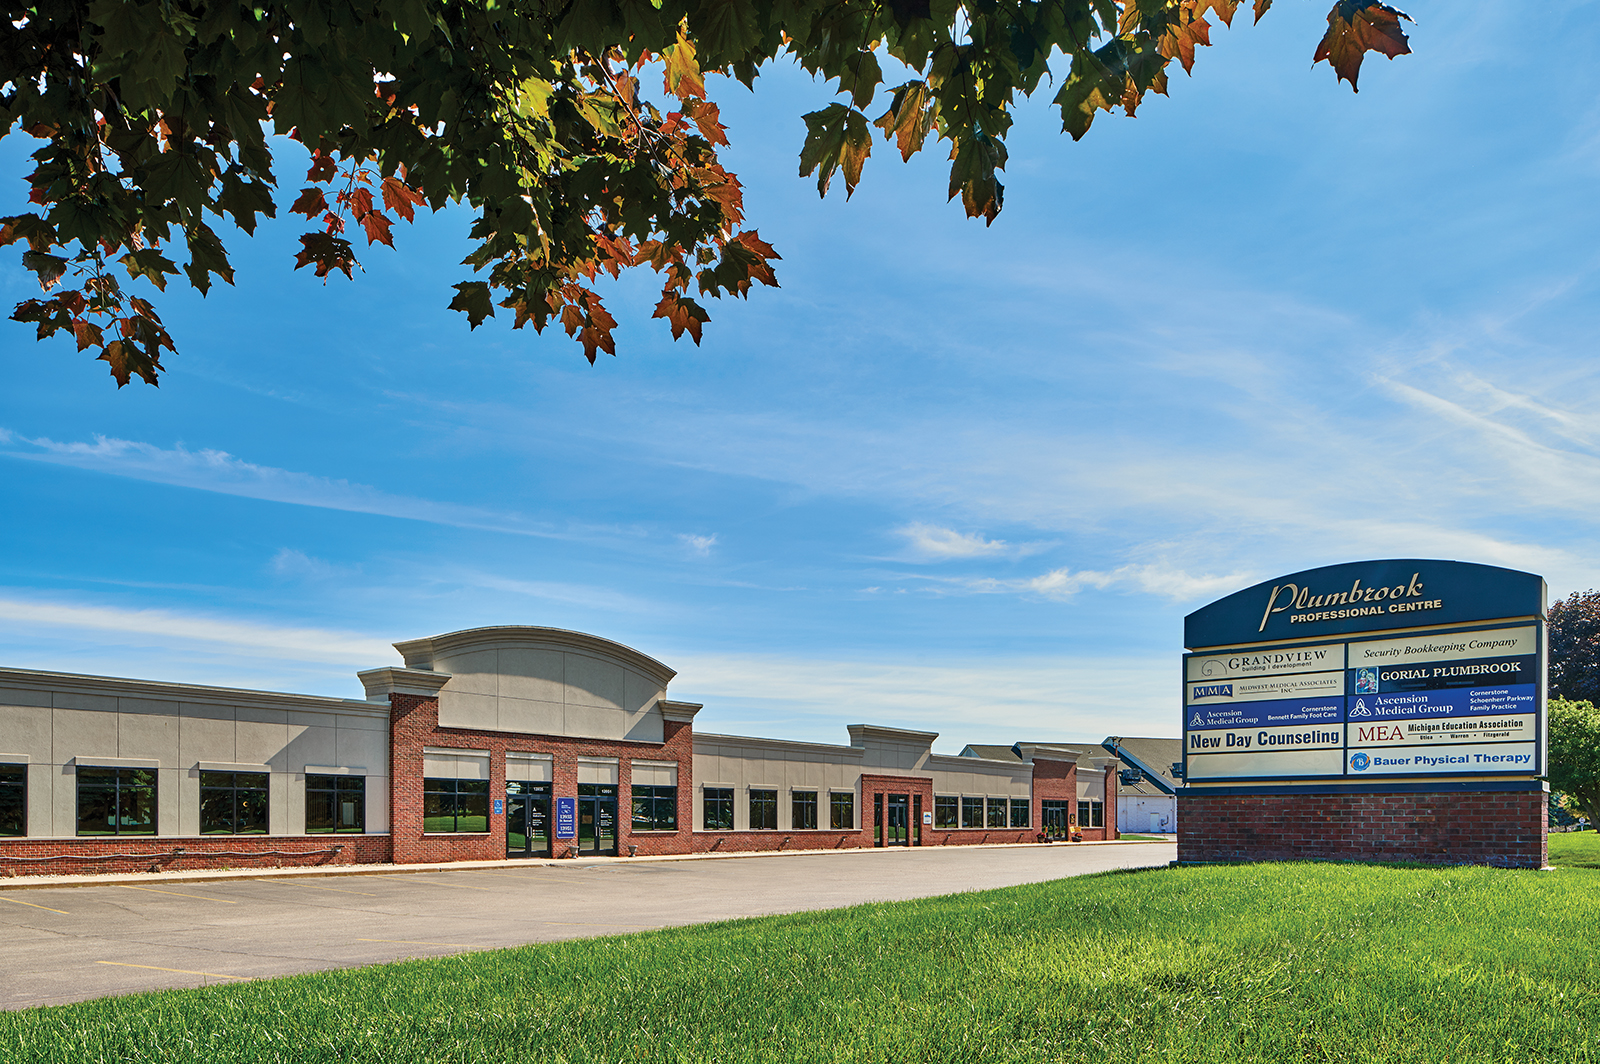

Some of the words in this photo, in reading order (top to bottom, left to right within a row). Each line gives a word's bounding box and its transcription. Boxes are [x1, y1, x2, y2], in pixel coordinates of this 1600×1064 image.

[1258, 572, 1423, 632] Plumbrook
[1290, 605, 1385, 624] PROFESSIONAL
[1388, 599, 1442, 613] CENTRE
[1364, 647, 1402, 658] Security
[1404, 642, 1466, 655] Bookkeeping
[1468, 637, 1518, 650] Company
[1228, 650, 1327, 670] GRANDVIEW
[1242, 664, 1266, 672] building
[1272, 661, 1312, 670] development
[1381, 668, 1430, 681] GORIAL
[1433, 661, 1522, 678] PLUMBROOK
[1299, 679, 1337, 687] ASSOCIATES
[1194, 686, 1230, 696] MMA
[1470, 688, 1509, 696] Cornerstone
[1375, 695, 1428, 706] Ascension
[1470, 696, 1506, 704] Schoenherr
[1507, 695, 1534, 703] Parkway
[1301, 705, 1337, 713] Cornerstone
[1375, 705, 1416, 716] Medical
[1419, 703, 1453, 715] Group
[1470, 704, 1491, 712] Family
[1492, 703, 1517, 711] Practice
[1207, 710, 1242, 718] Ascension
[1290, 713, 1309, 721] Family
[1207, 717, 1235, 726] Medical
[1235, 717, 1259, 725] Group
[1408, 722, 1440, 732] Michigan
[1442, 720, 1477, 730] Education
[1479, 719, 1523, 729] Association
[1358, 725, 1404, 742] MEA
[1190, 734, 1221, 749] New
[1225, 732, 1252, 748] Day
[1257, 730, 1340, 746] Counseling
[1373, 757, 1411, 766] Bauer
[1414, 754, 1469, 766] Physical
[1474, 753, 1531, 764] Therapy
